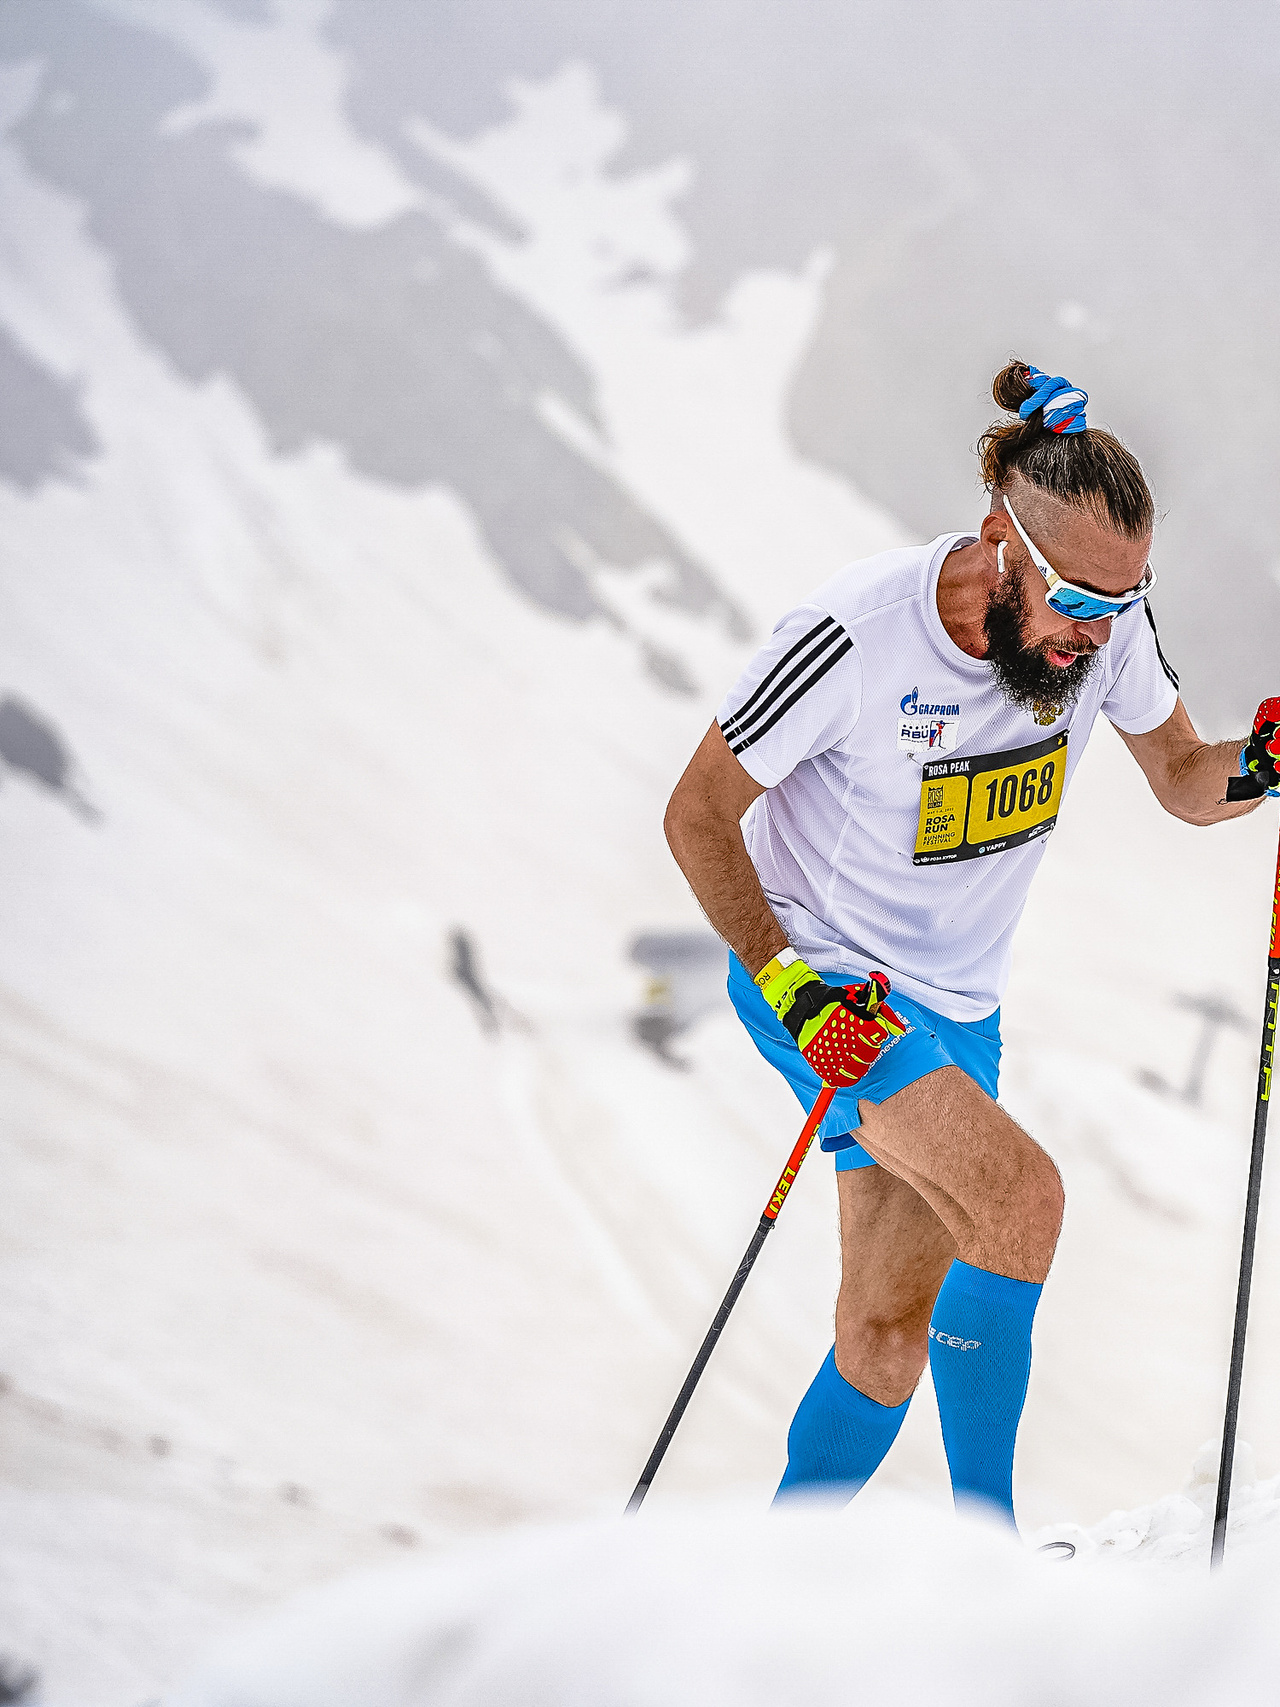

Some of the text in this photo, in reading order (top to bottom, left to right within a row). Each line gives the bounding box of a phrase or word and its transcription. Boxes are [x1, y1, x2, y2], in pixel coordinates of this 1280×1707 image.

[919, 704, 960, 716] GAZPROM
[901, 729, 929, 739] RBU
[928, 760, 970, 777] ROSA PEAK
[985, 761, 1056, 823] 1068
[926, 814, 955, 826] ROSA
[925, 823, 949, 835] RUN
[923, 838, 951, 846] FESTIVAL
[924, 832, 956, 842] RUNNING
[986, 841, 1007, 852] YAPPY
[769, 1166, 796, 1214] LEKI
